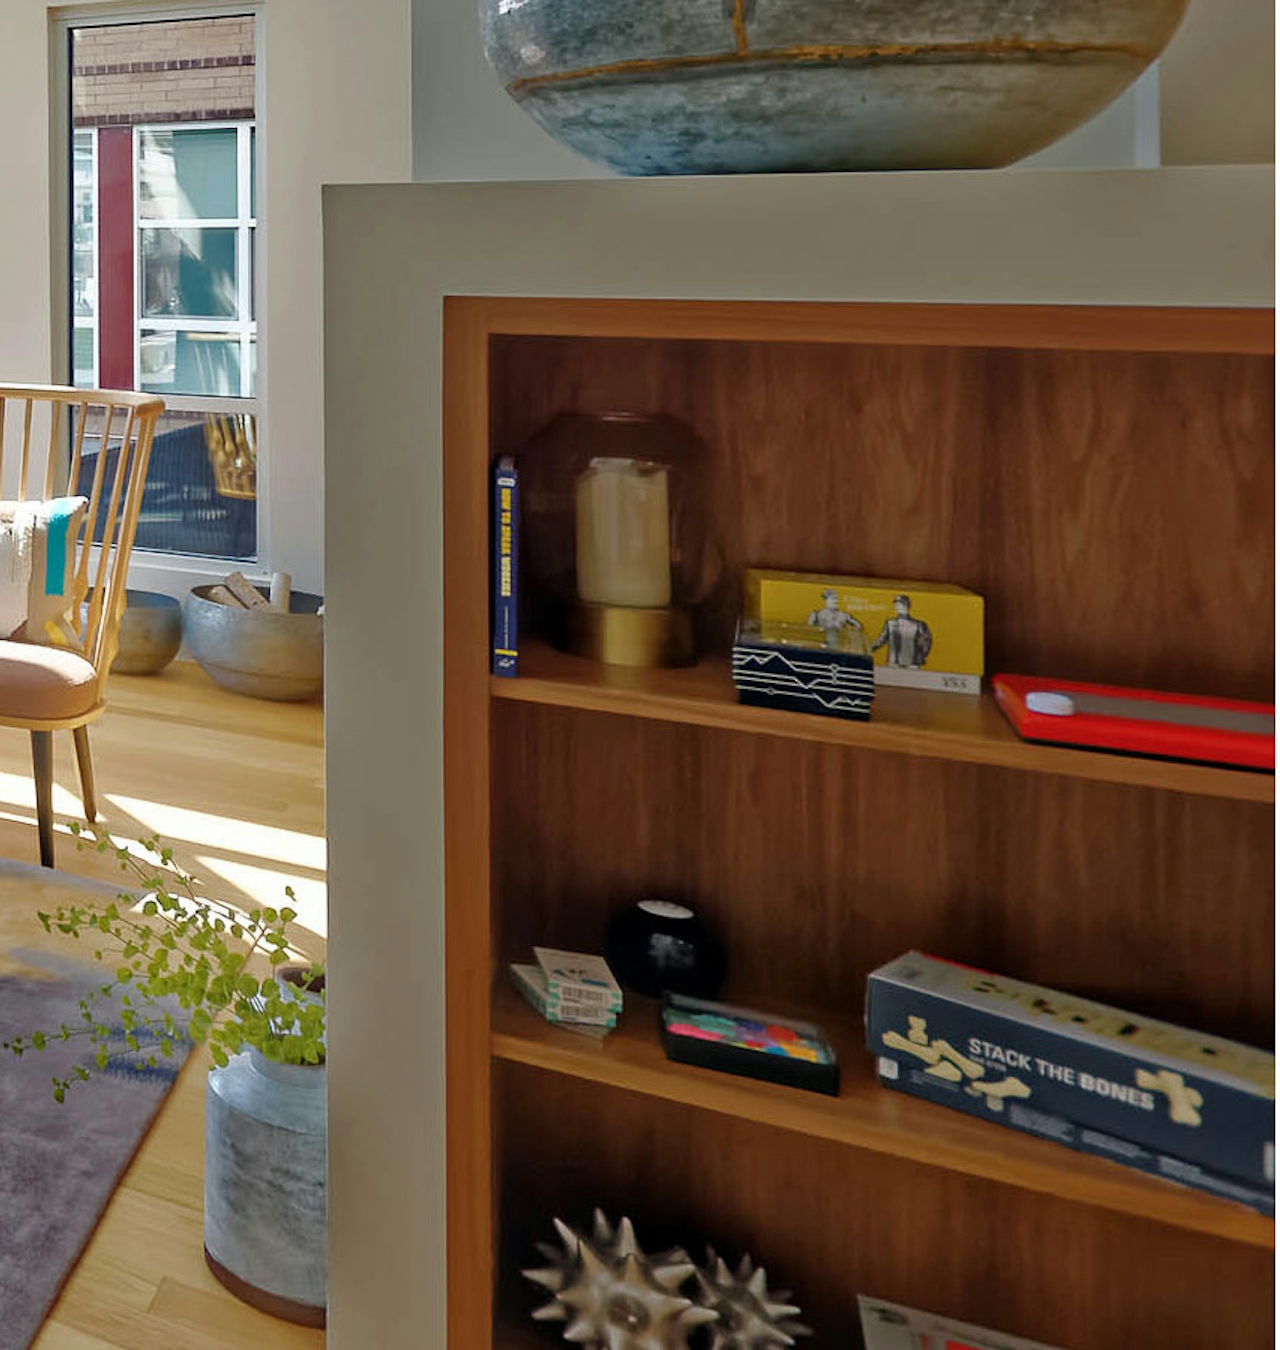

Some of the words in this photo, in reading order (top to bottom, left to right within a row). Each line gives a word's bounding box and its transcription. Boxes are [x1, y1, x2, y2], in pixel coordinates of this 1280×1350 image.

[968, 1037, 1032, 1071] STACK
[1034, 1057, 1076, 1085] THE
[1078, 1071, 1156, 1111] BONES
